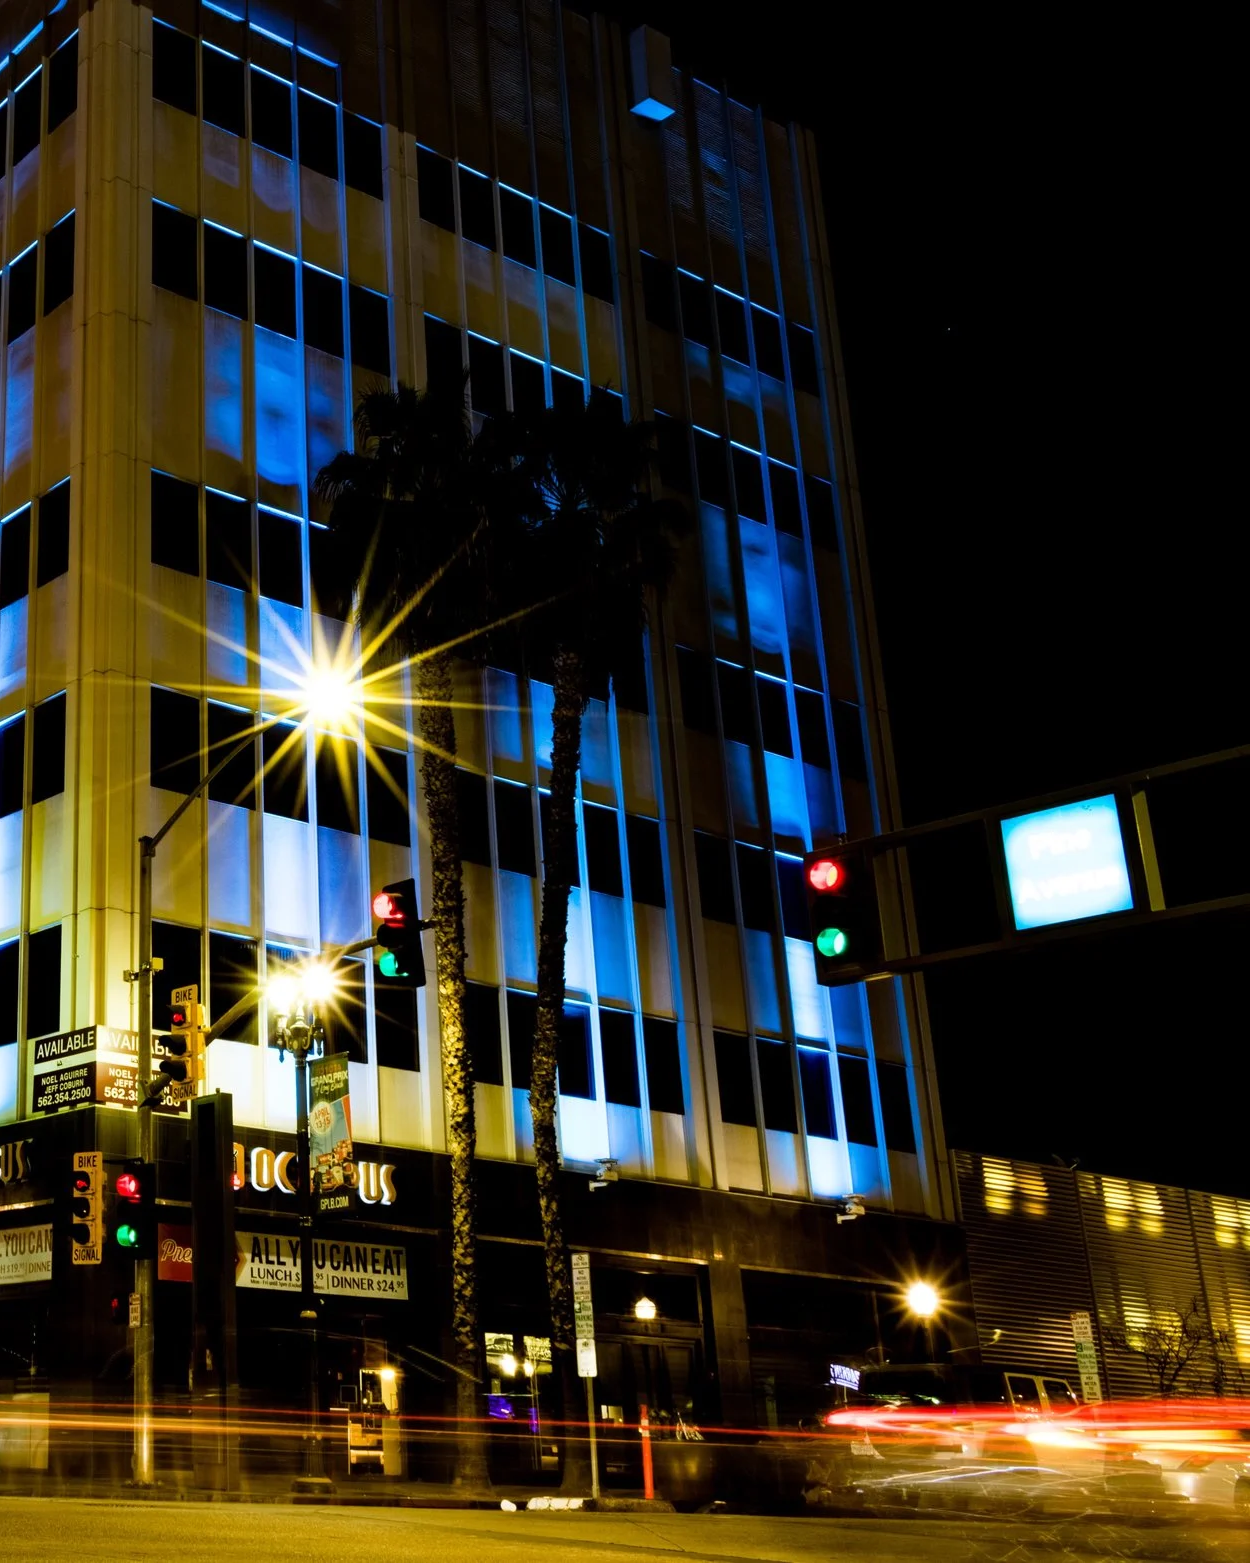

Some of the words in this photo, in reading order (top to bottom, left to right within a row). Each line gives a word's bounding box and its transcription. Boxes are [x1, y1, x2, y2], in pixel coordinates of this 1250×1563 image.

[175, 988, 193, 1003] BIKE
[36, 1031, 95, 1060] AVAILABLE
[42, 1075, 58, 1085] NOEL
[59, 1068, 88, 1082] AGUIRRE
[109, 1068, 133, 1079] NOEL
[44, 1083, 58, 1094] JEFF
[59, 1078, 84, 1090] COBURN
[114, 1078, 133, 1088] JEFF
[37, 1086, 91, 1108] 562.354.2500
[173, 1084, 197, 1100] SIGNAL
[78, 1155, 97, 1168] BIKE
[250, 1147, 397, 1205] OCUS
[320, 1195, 349, 1210] GPLB.COM
[4, 1233, 26, 1257] YOU
[28, 1229, 53, 1255] CAN
[74, 1249, 100, 1261] SIGNAL
[251, 1236, 287, 1266] ALL
[288, 1239, 326, 1270] YU
[329, 1244, 368, 1274] CAN
[371, 1248, 404, 1276] EAT
[28, 1261, 52, 1274] DINNE
[251, 1267, 292, 1282] LUNCH
[332, 1275, 375, 1292] DINNER
[377, 1279, 404, 1292] $24.95
